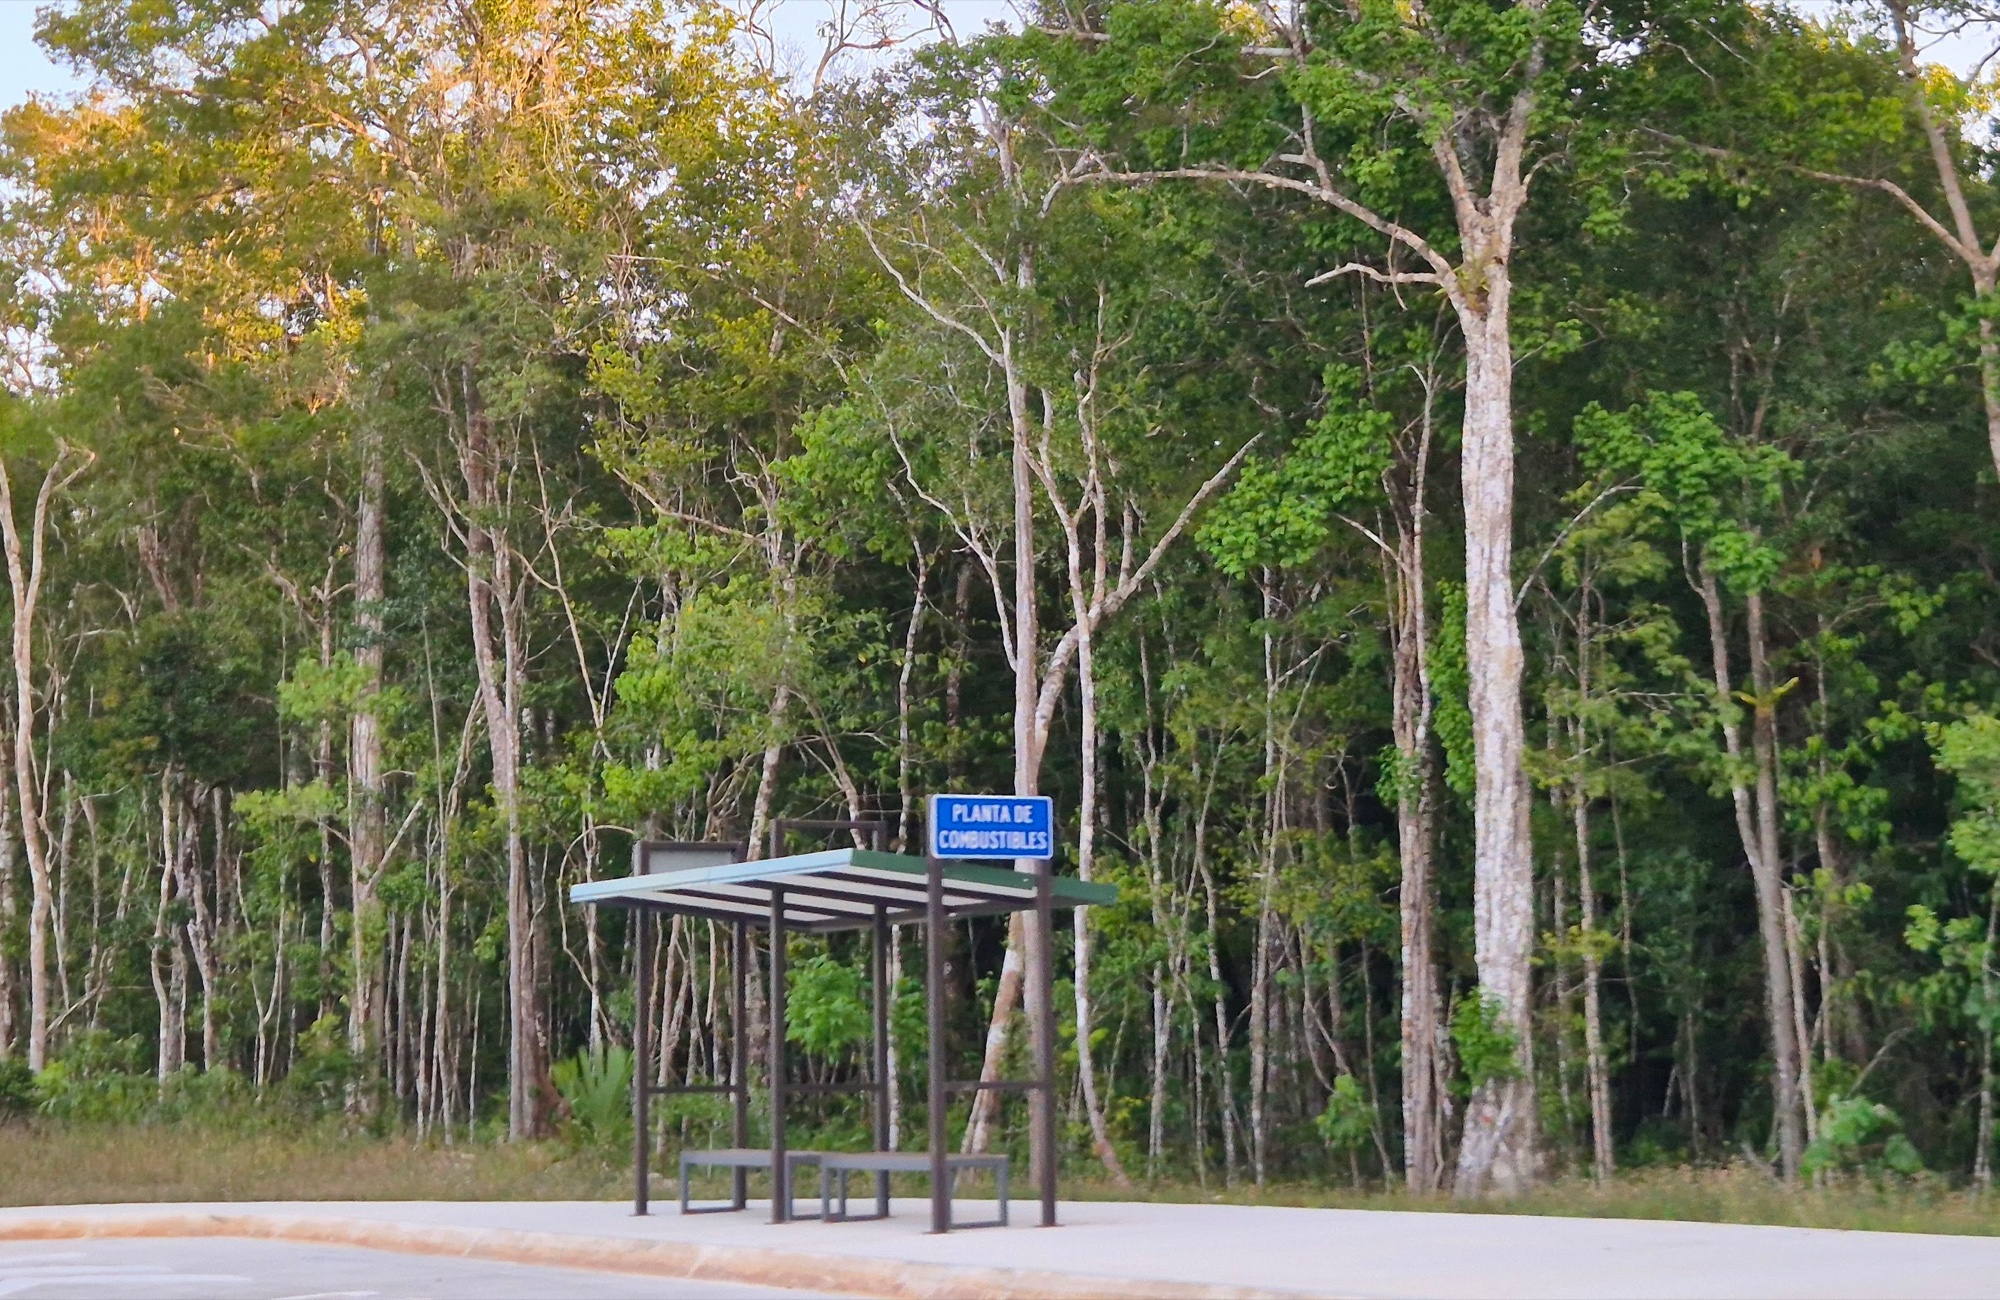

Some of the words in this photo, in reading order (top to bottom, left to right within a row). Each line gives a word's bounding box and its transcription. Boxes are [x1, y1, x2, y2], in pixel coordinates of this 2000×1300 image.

[952, 804, 1011, 823] PLANTA
[1013, 805, 1034, 824] DE
[938, 829, 1048, 850] COMBUSTIBLES
